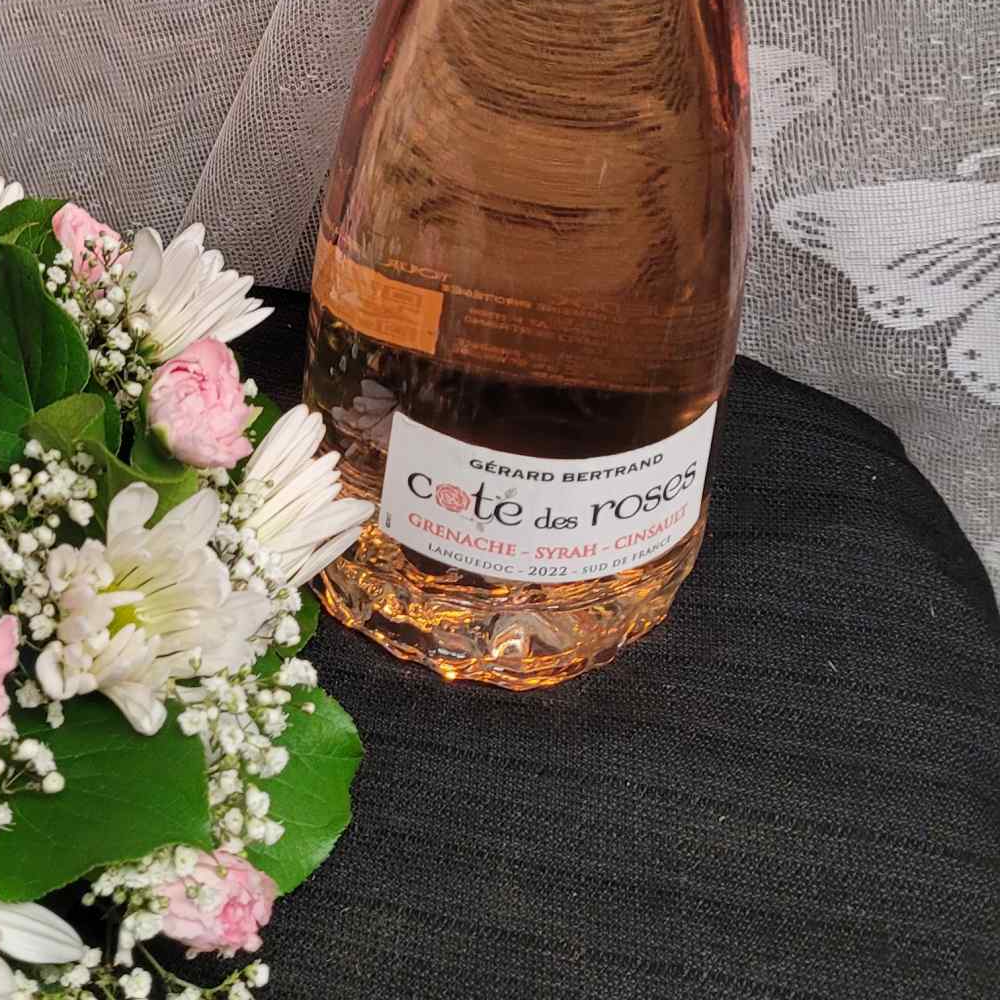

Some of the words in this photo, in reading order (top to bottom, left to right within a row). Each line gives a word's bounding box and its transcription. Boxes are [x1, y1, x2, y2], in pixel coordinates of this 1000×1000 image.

[469, 458, 554, 483] GÉRARD
[562, 453, 664, 482] BERTRAND
[534, 507, 579, 530] des
[589, 461, 697, 527] roses
[408, 512, 517, 557] GRENACHE
[535, 543, 598, 560] SYRAH
[615, 501, 688, 550] CINSAULT
[427, 542, 515, 575] LANGUEDOC
[527, 565, 568, 577] 2022
[582, 561, 608, 576] SUD
[612, 553, 627, 569] DE
[632, 535, 672, 563] FRANCE
